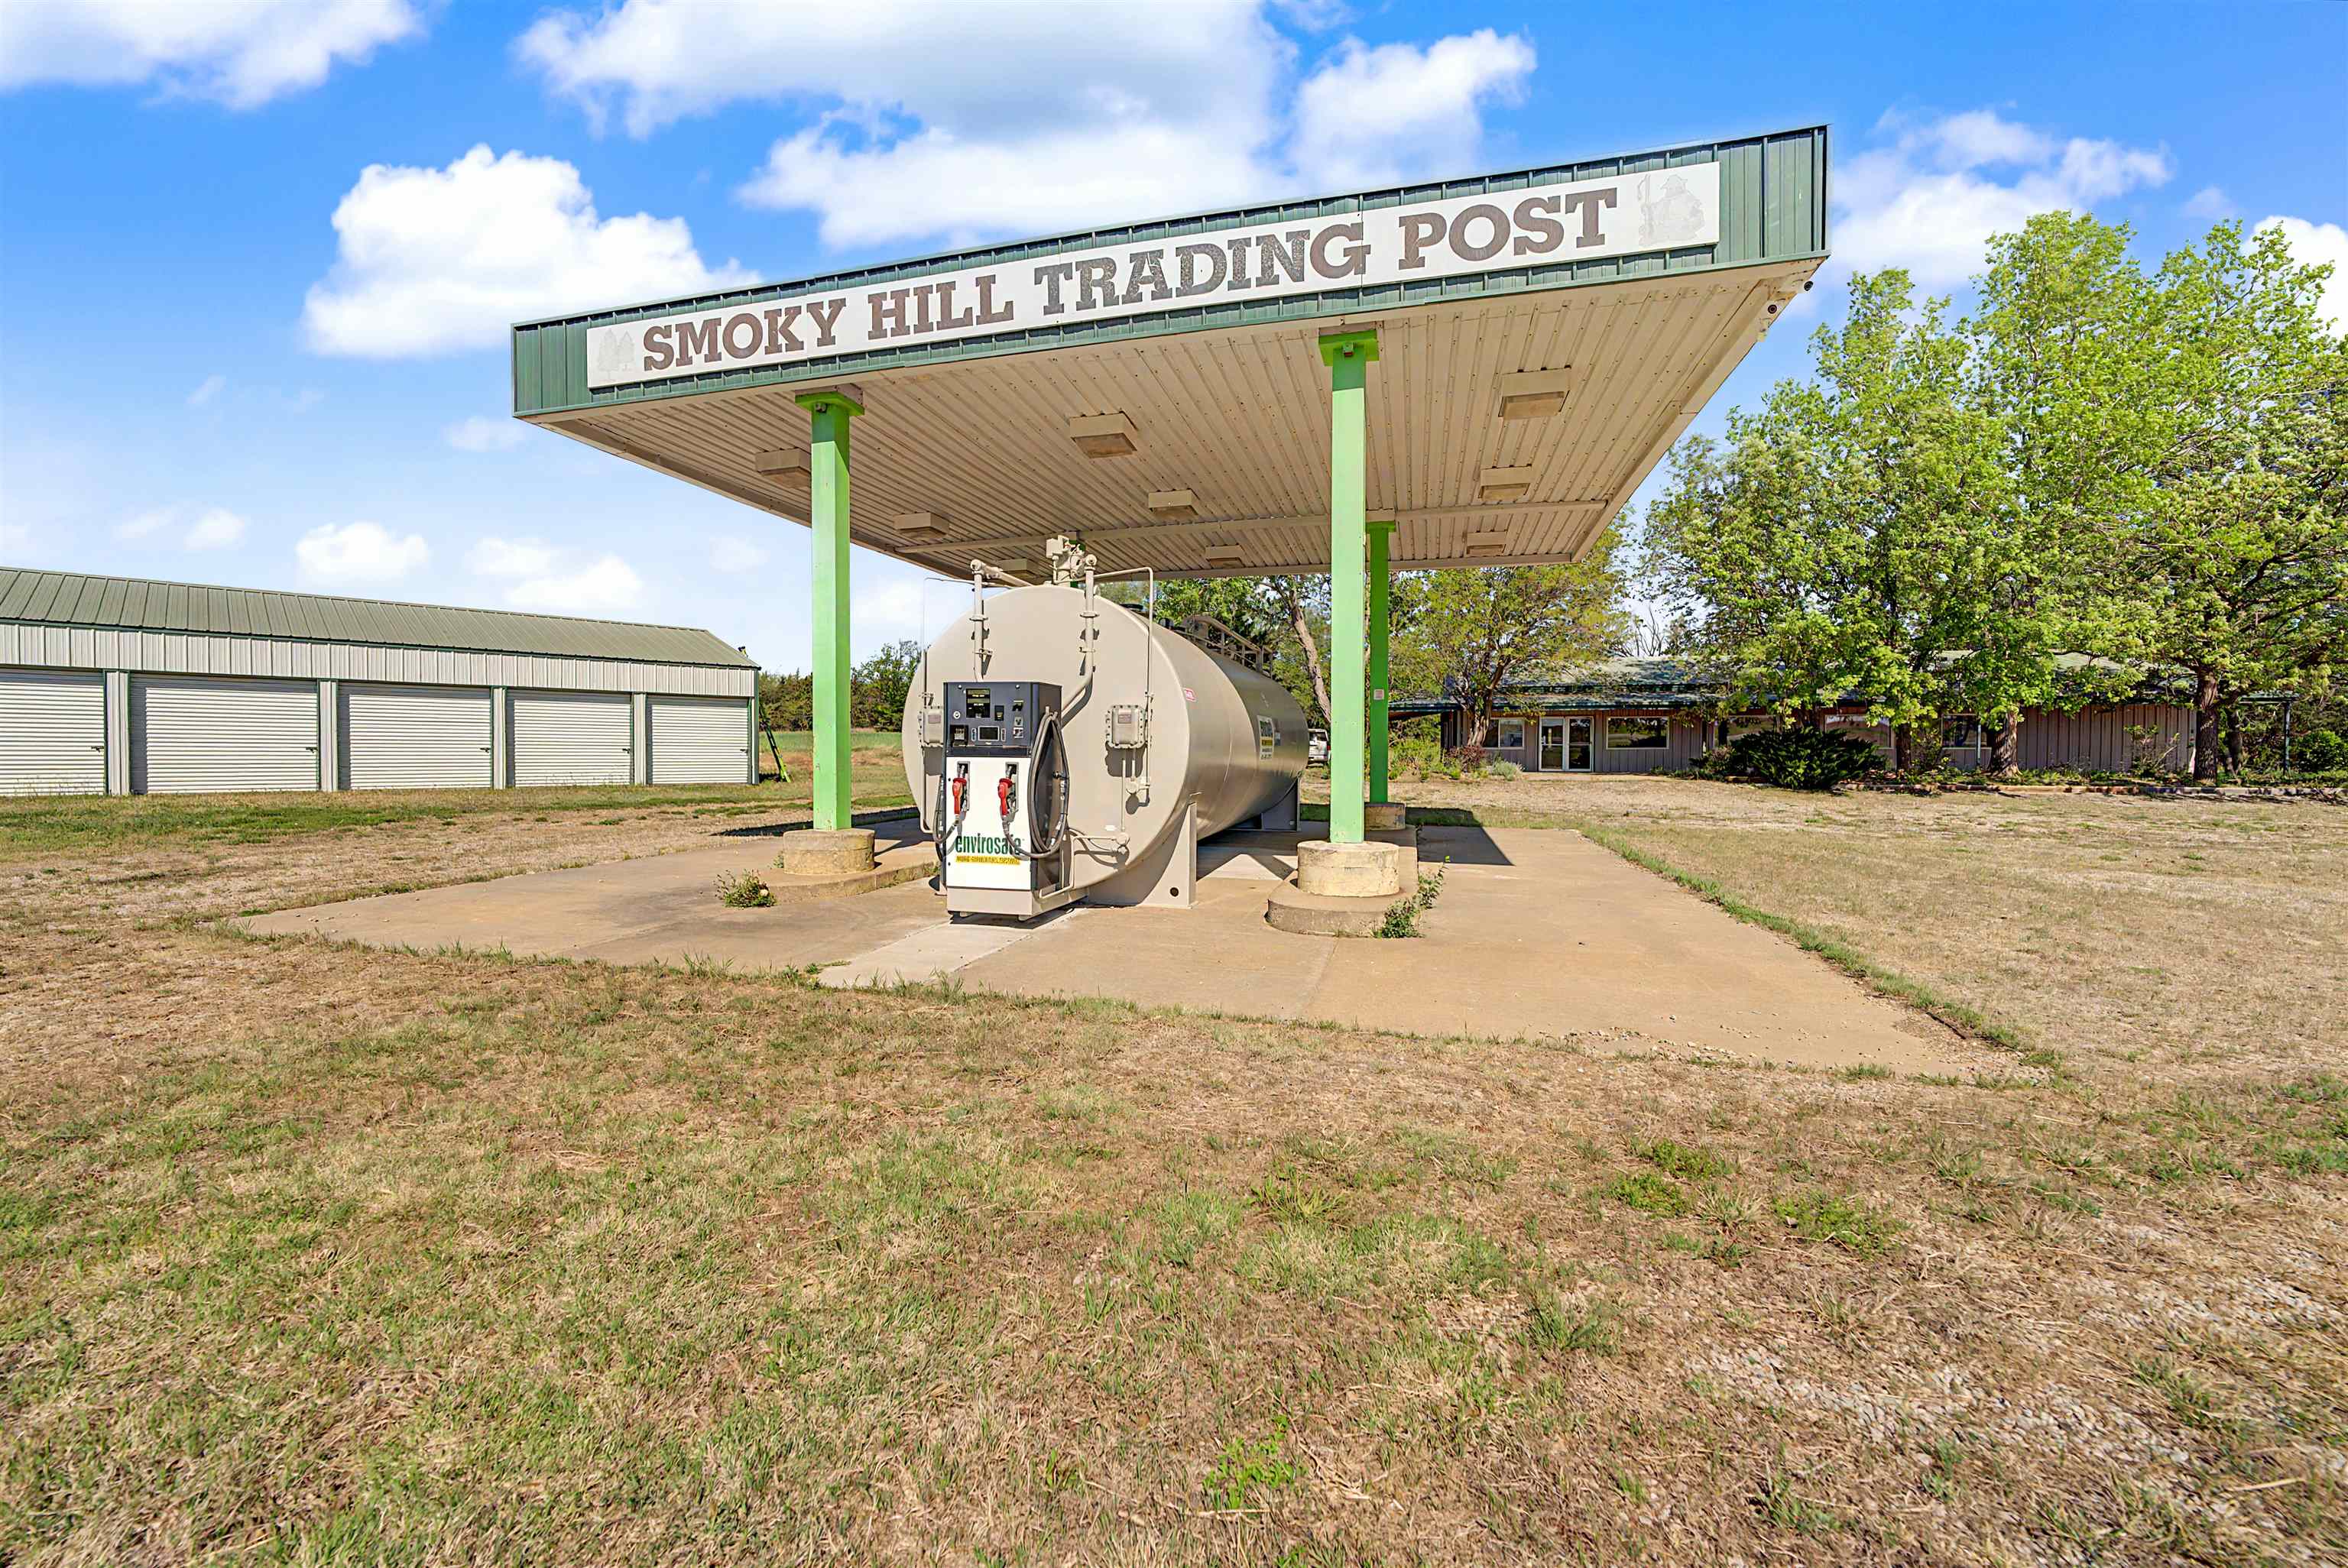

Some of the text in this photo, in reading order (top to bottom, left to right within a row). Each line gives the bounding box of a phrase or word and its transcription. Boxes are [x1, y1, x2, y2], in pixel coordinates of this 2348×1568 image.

[643, 187, 1617, 371] SMOKY HILL TRADING POST
